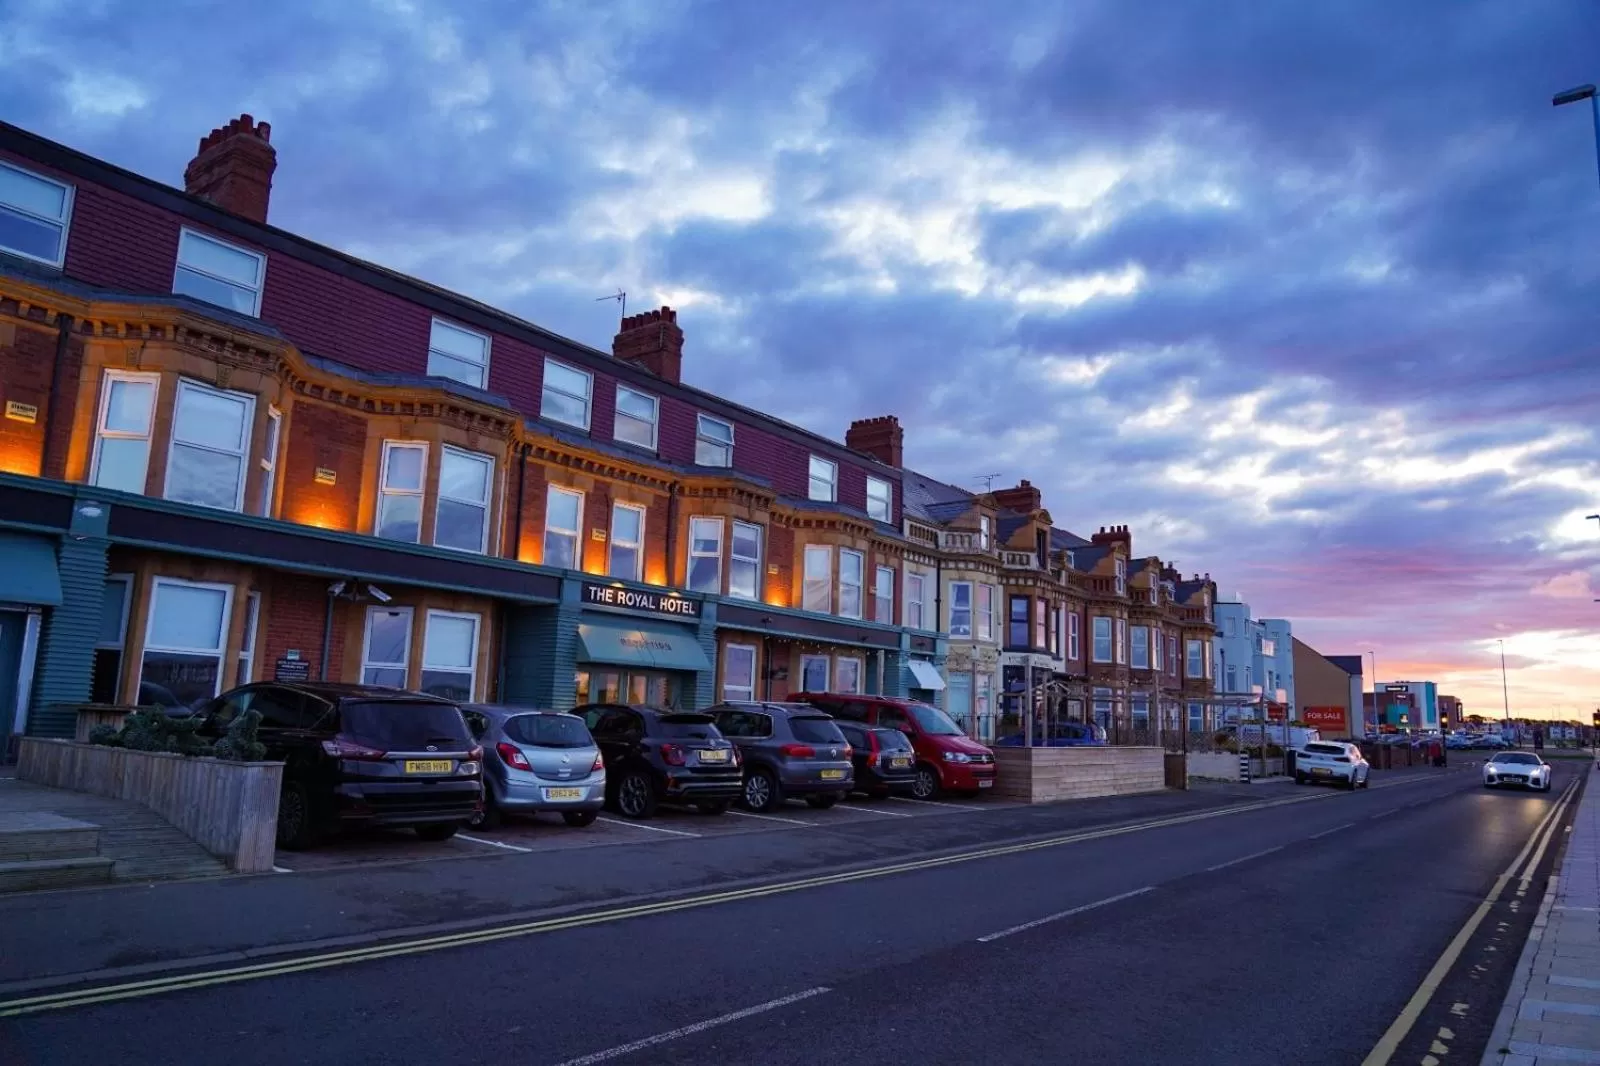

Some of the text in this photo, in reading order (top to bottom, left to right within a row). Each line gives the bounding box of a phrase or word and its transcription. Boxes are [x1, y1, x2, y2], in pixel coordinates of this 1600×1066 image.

[588, 586, 696, 614] THE ROYAL HOTEL
[1323, 712, 1341, 720] SALE
